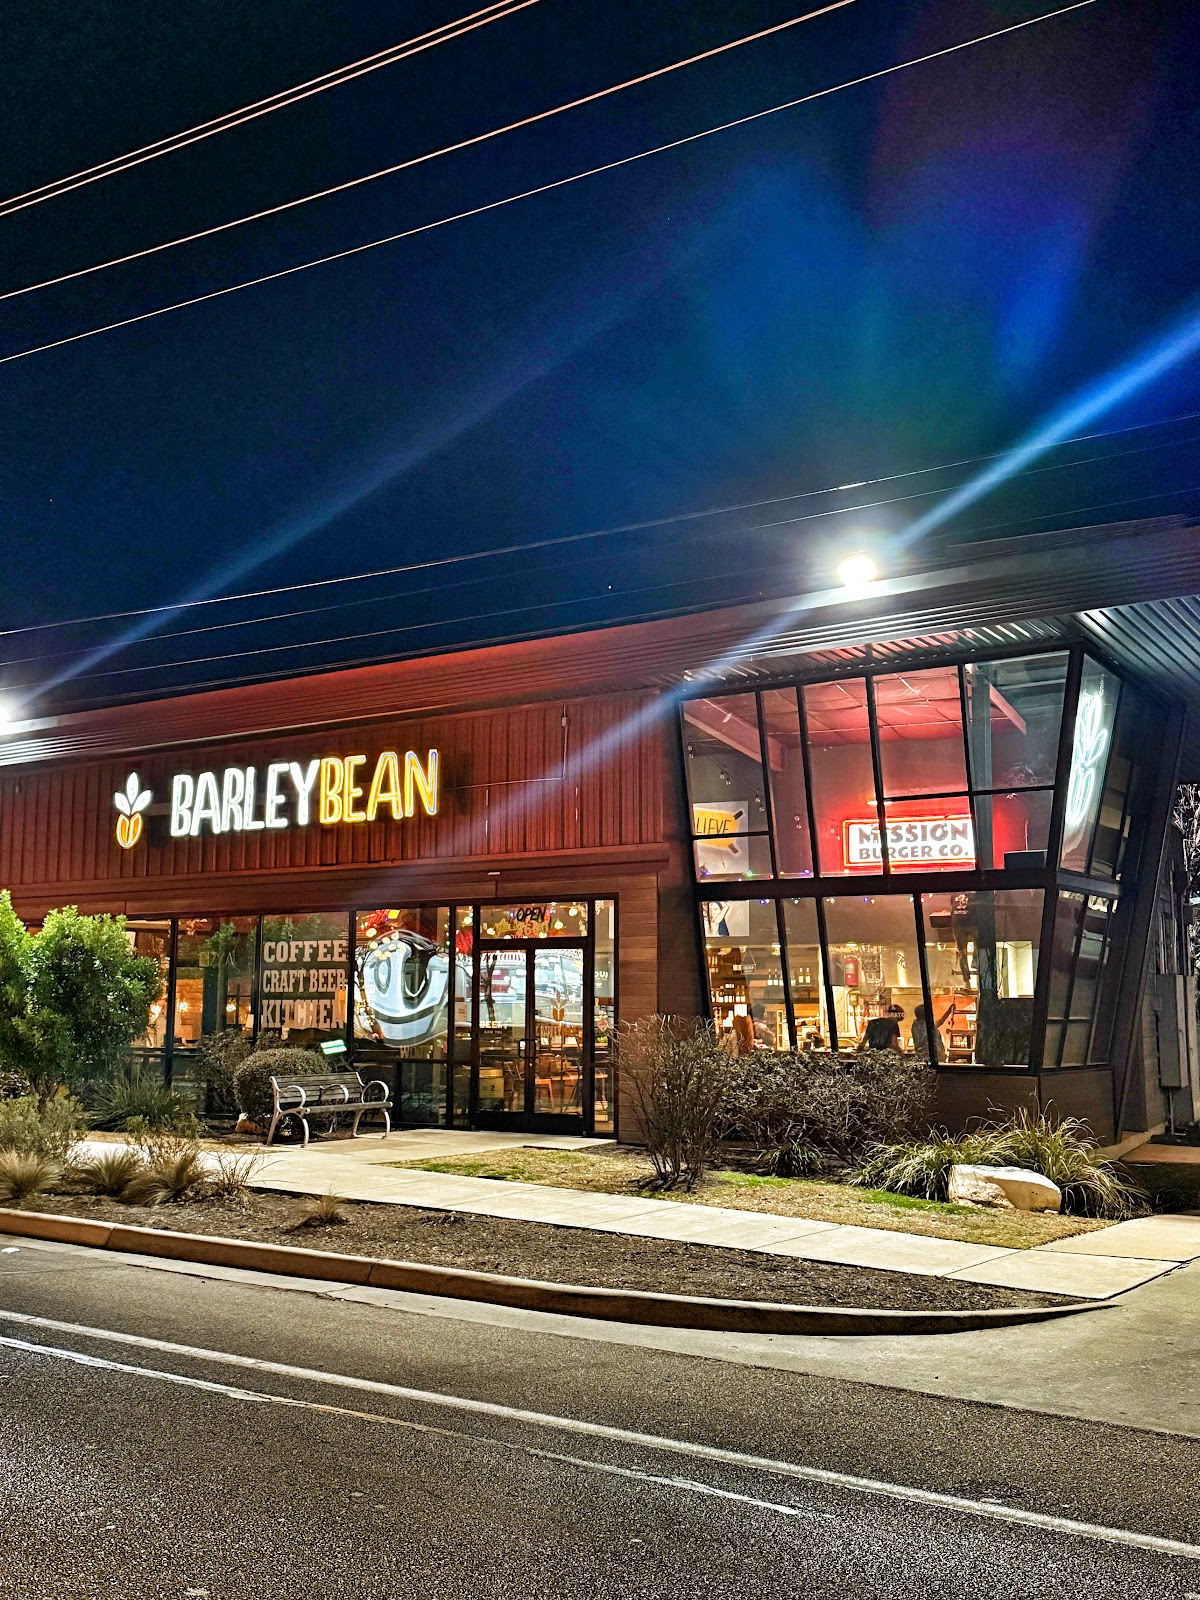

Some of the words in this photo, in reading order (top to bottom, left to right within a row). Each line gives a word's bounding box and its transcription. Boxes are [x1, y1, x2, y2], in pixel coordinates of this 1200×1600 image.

[858, 822, 969, 845] MSSION
[858, 845, 934, 860] BURGER
[938, 844, 969, 857] CO.
[516, 905, 547, 922] OPEN
[263, 940, 348, 963] COFFEE
[262, 969, 306, 993] CRAFT
[308, 968, 348, 993] BEER
